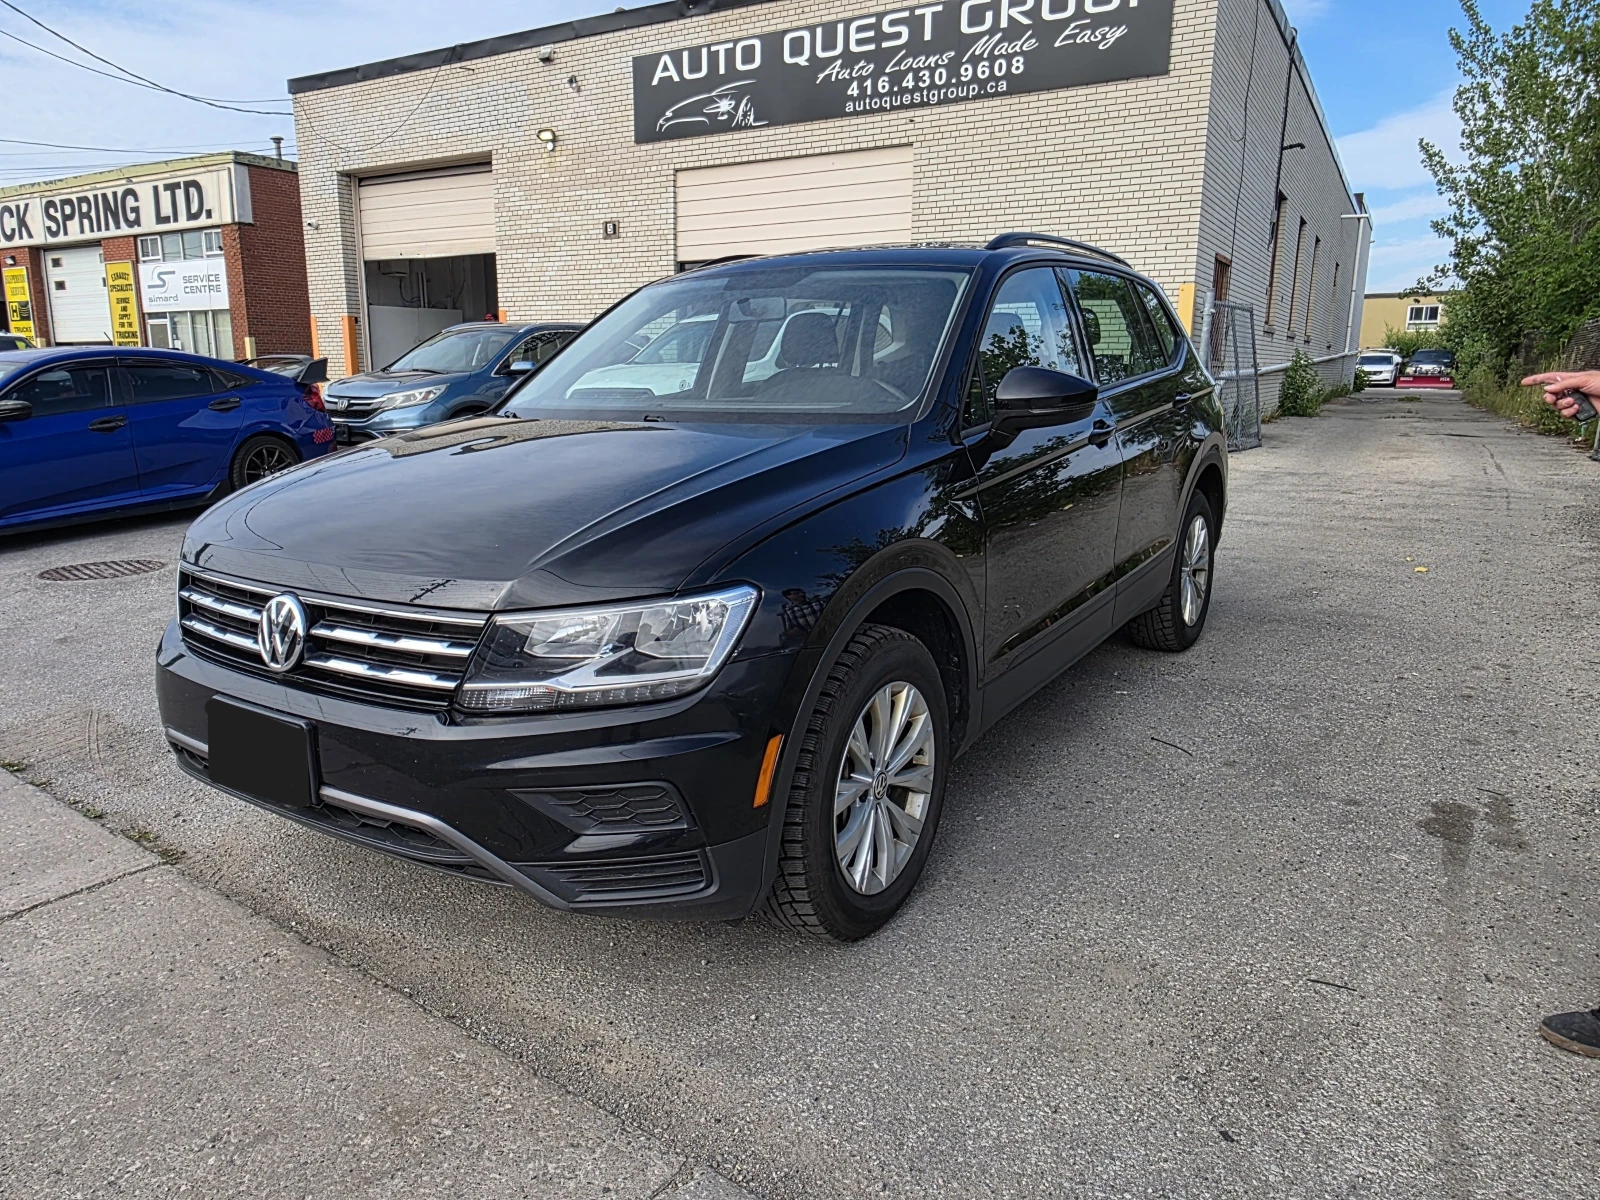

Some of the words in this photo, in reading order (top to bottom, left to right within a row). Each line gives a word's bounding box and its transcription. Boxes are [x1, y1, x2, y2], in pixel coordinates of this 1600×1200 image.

[651, 38, 761, 86] AUTO
[783, 5, 944, 66] QUEST
[960, 0, 1138, 34] GRO
[816, 59, 874, 84] Auto
[885, 49, 955, 73] Loans
[962, 29, 1039, 62] Made
[1054, 19, 1128, 50] Easy
[847, 56, 1025, 97] 416.430.9608
[845, 80, 1007, 112] autoquestgroup.ca
[0, 203, 33, 242] CK
[44, 188, 141, 239] SPRING
[152, 179, 212, 225] LTD.
[111, 272, 129, 282] EXHAUST
[182, 273, 220, 284] SERVICE
[110, 283, 133, 292] SPECIALISTS
[183, 284, 221, 294] CENTRE
[148, 294, 178, 303] simard
[115, 331, 138, 339] TRUCKING
